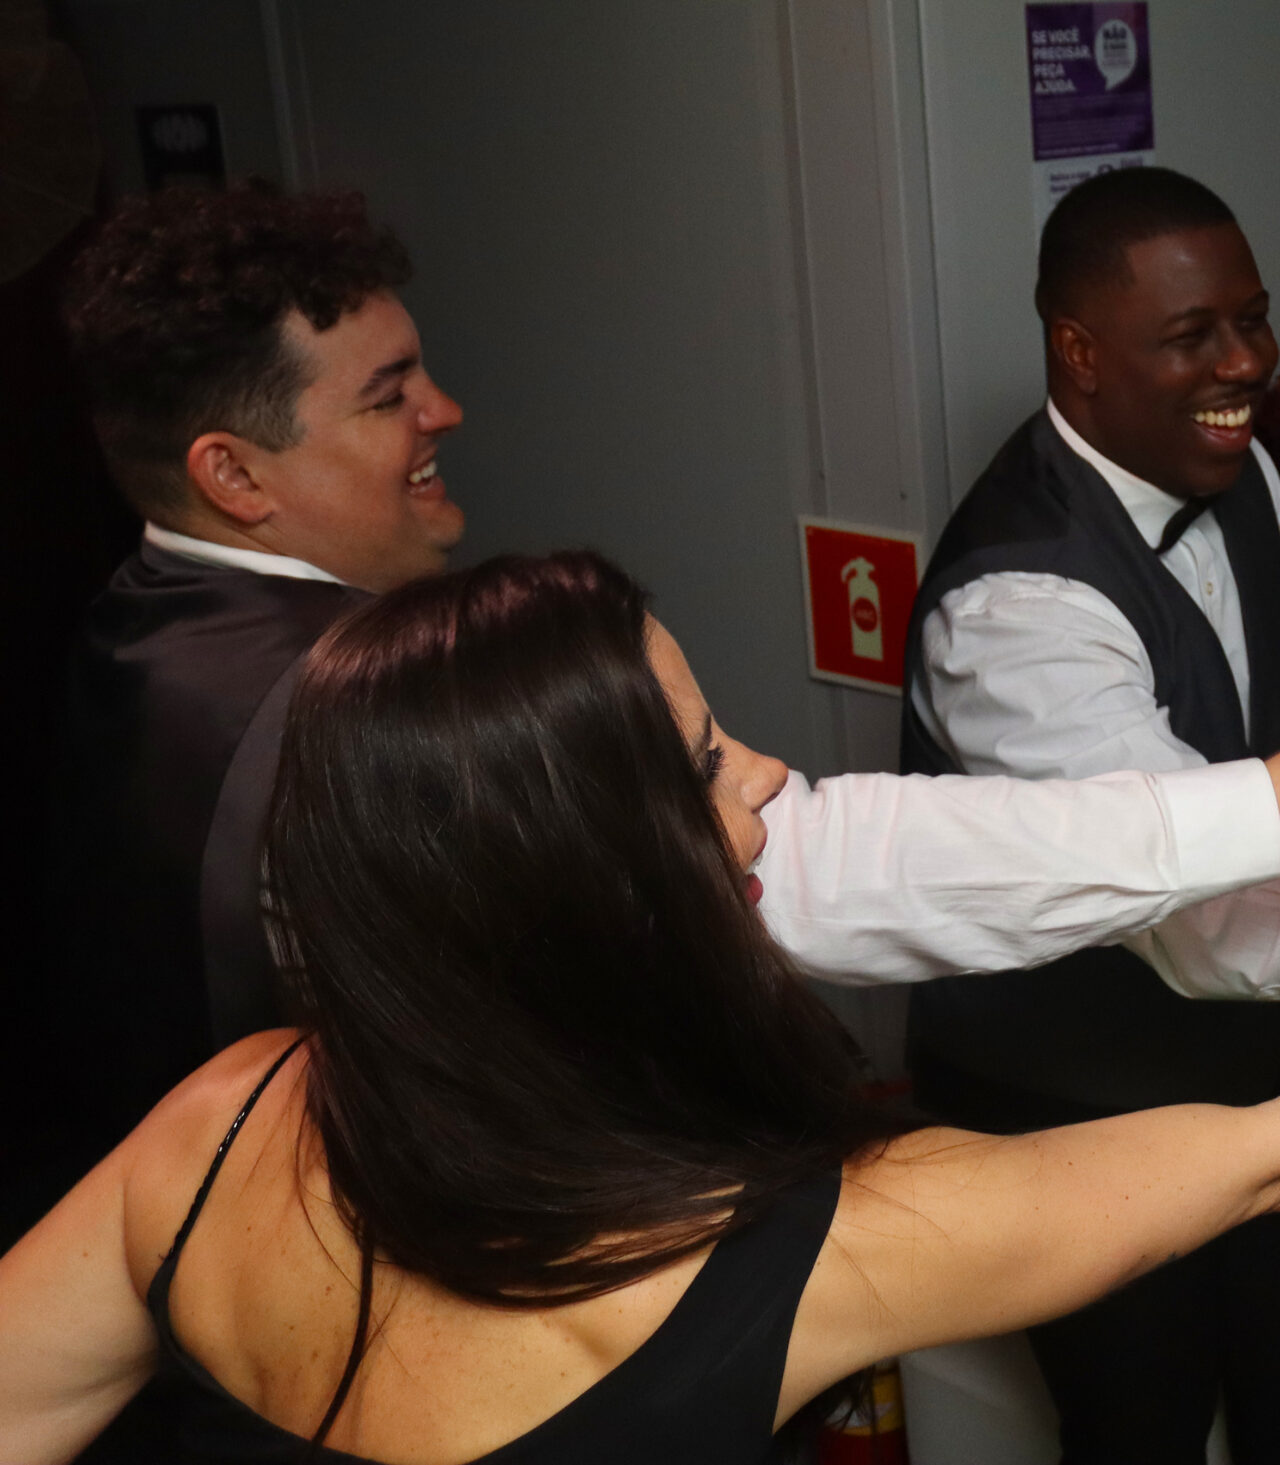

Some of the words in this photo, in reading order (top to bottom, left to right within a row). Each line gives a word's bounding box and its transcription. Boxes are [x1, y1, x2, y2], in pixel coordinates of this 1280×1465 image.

[1031, 30, 1047, 44] SE
[1047, 26, 1080, 44] VOCÊ
[1034, 62, 1066, 78] PEÇA
